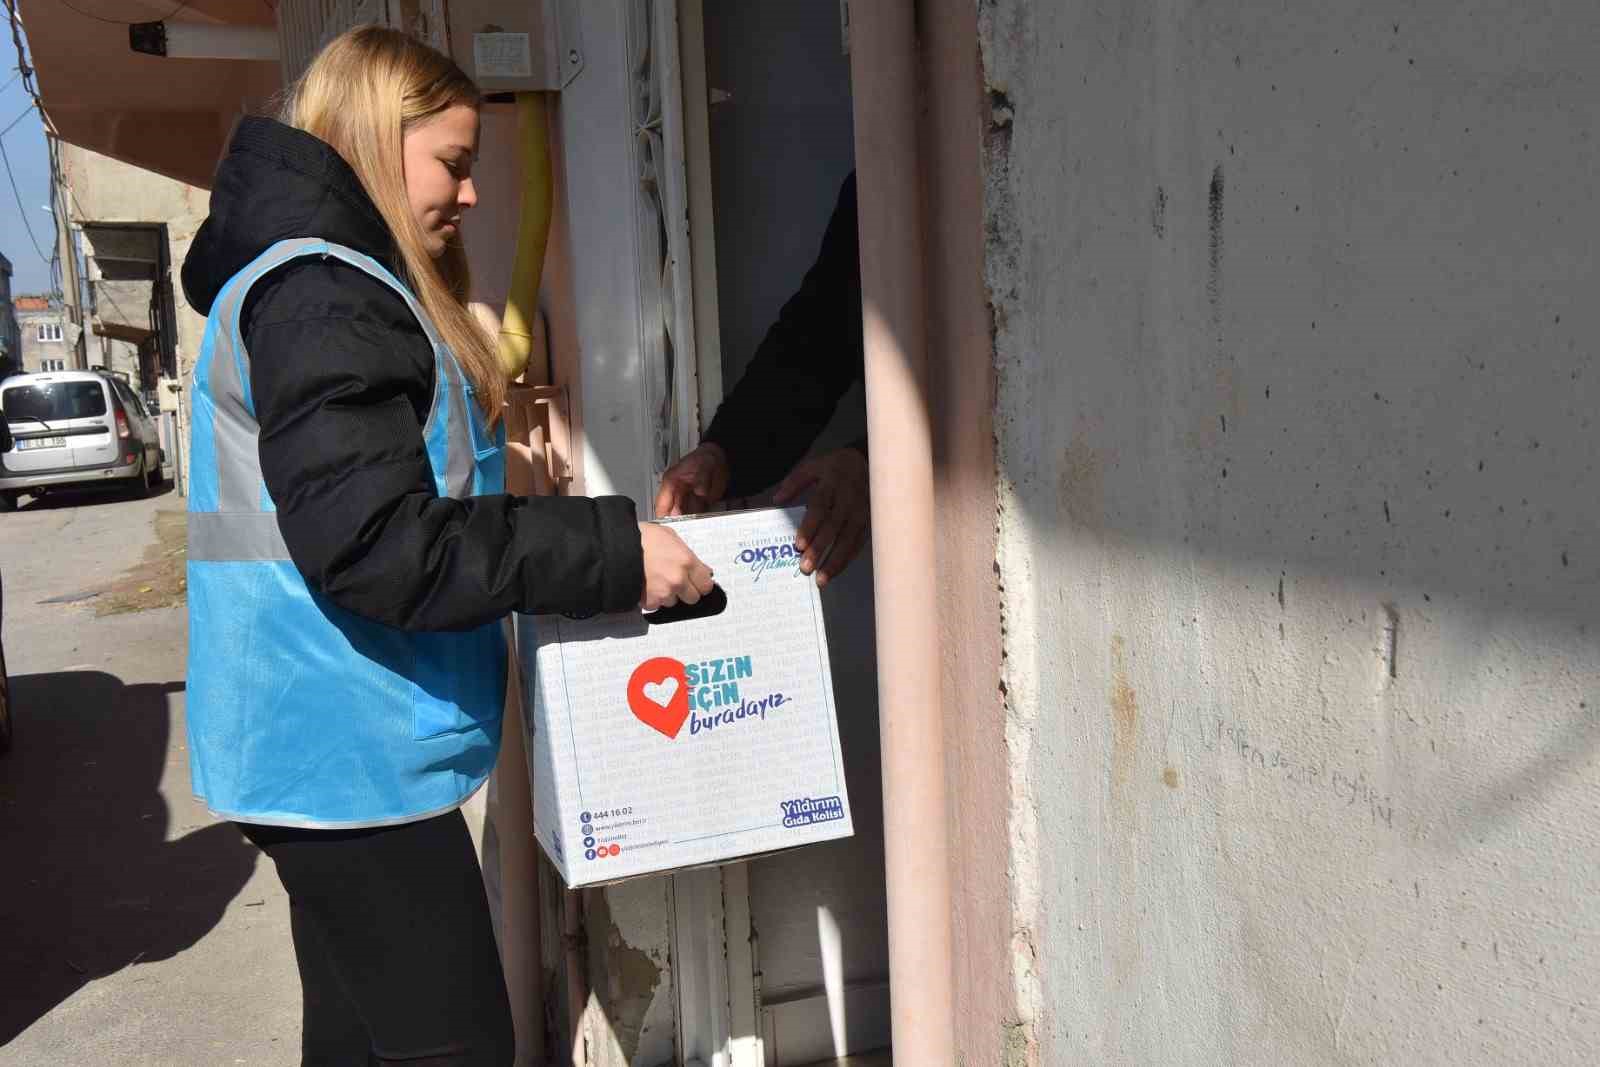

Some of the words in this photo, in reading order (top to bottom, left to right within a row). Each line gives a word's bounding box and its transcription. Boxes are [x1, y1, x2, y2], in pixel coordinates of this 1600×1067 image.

[685, 655, 753, 686] SİZİN
[688, 682, 740, 712] İÇİN
[690, 693, 792, 735] buradayız
[611, 808, 621, 817] 16
[622, 806, 633, 816] 02
[782, 797, 840, 816] Yıldırım
